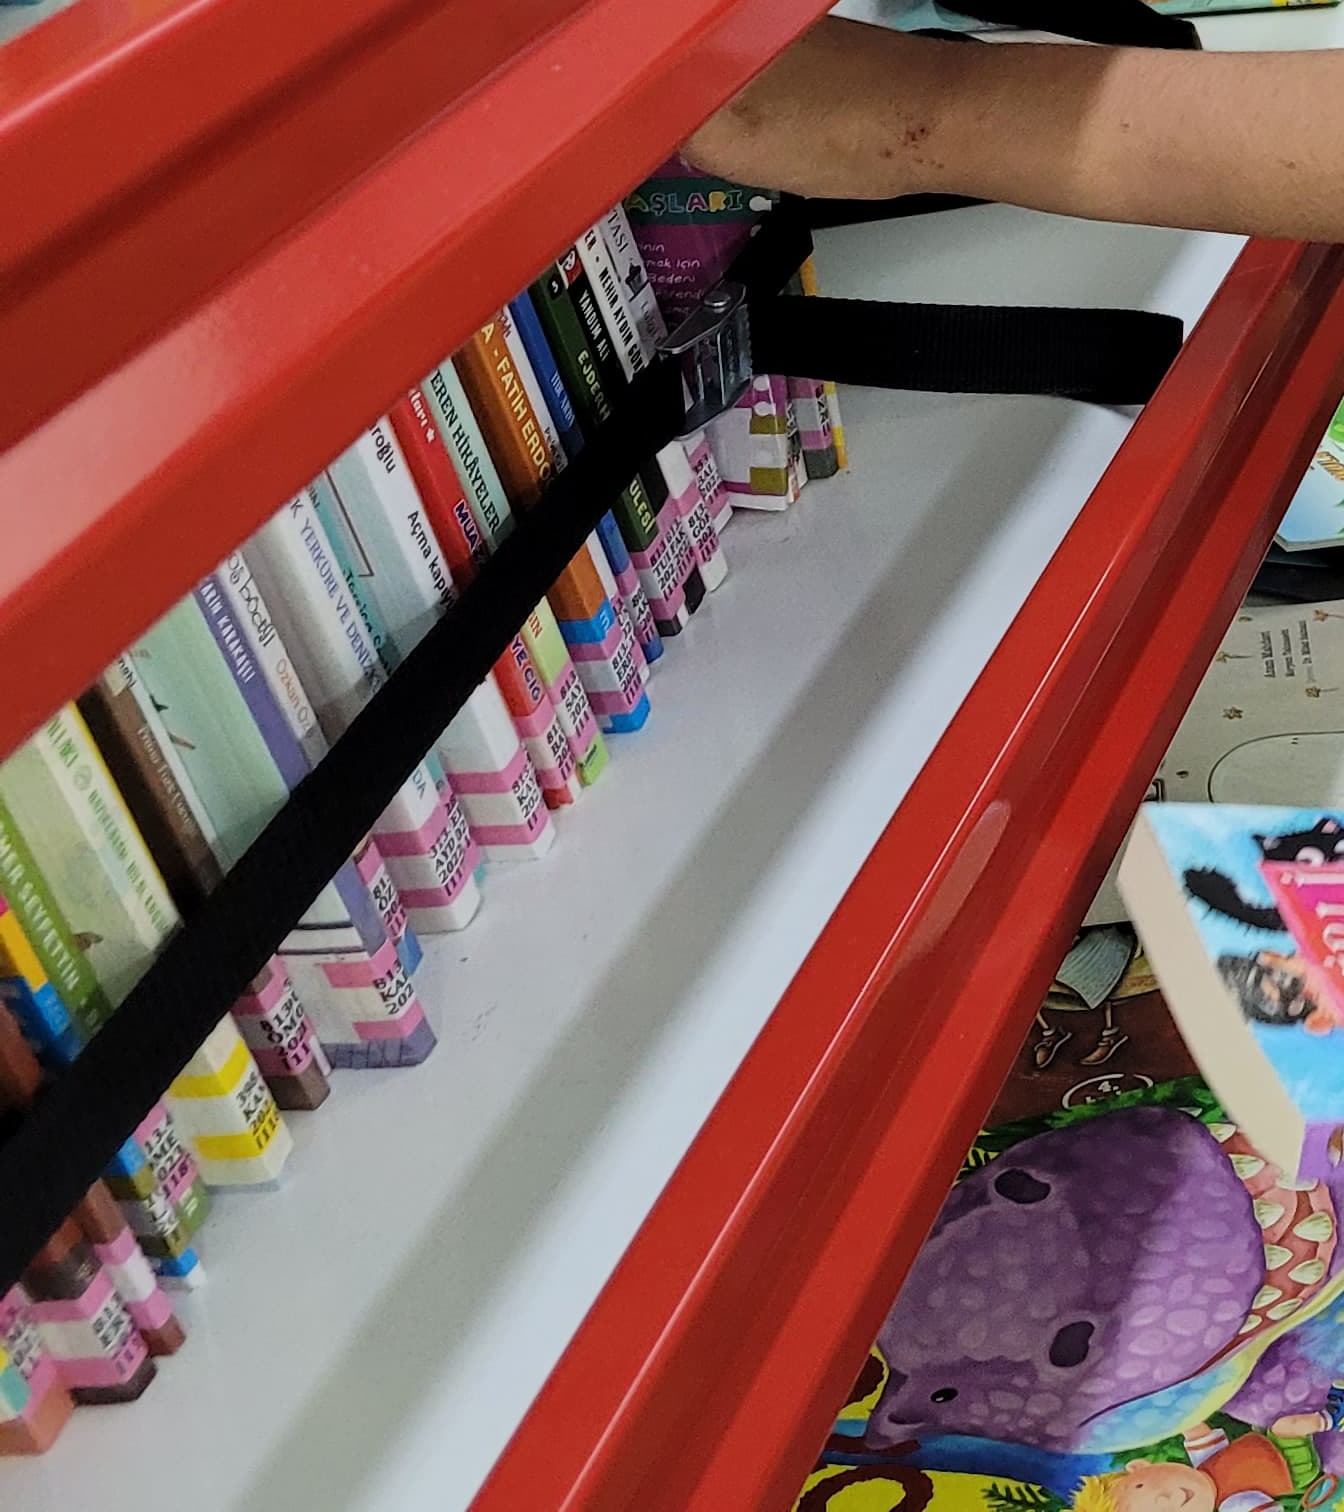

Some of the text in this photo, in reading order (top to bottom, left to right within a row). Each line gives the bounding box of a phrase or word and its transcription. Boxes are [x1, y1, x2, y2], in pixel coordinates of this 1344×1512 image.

[491, 357, 533, 421] FATİH
[401, 509, 440, 560] Açma
[294, 516, 354, 624] YERKÜRE VE
